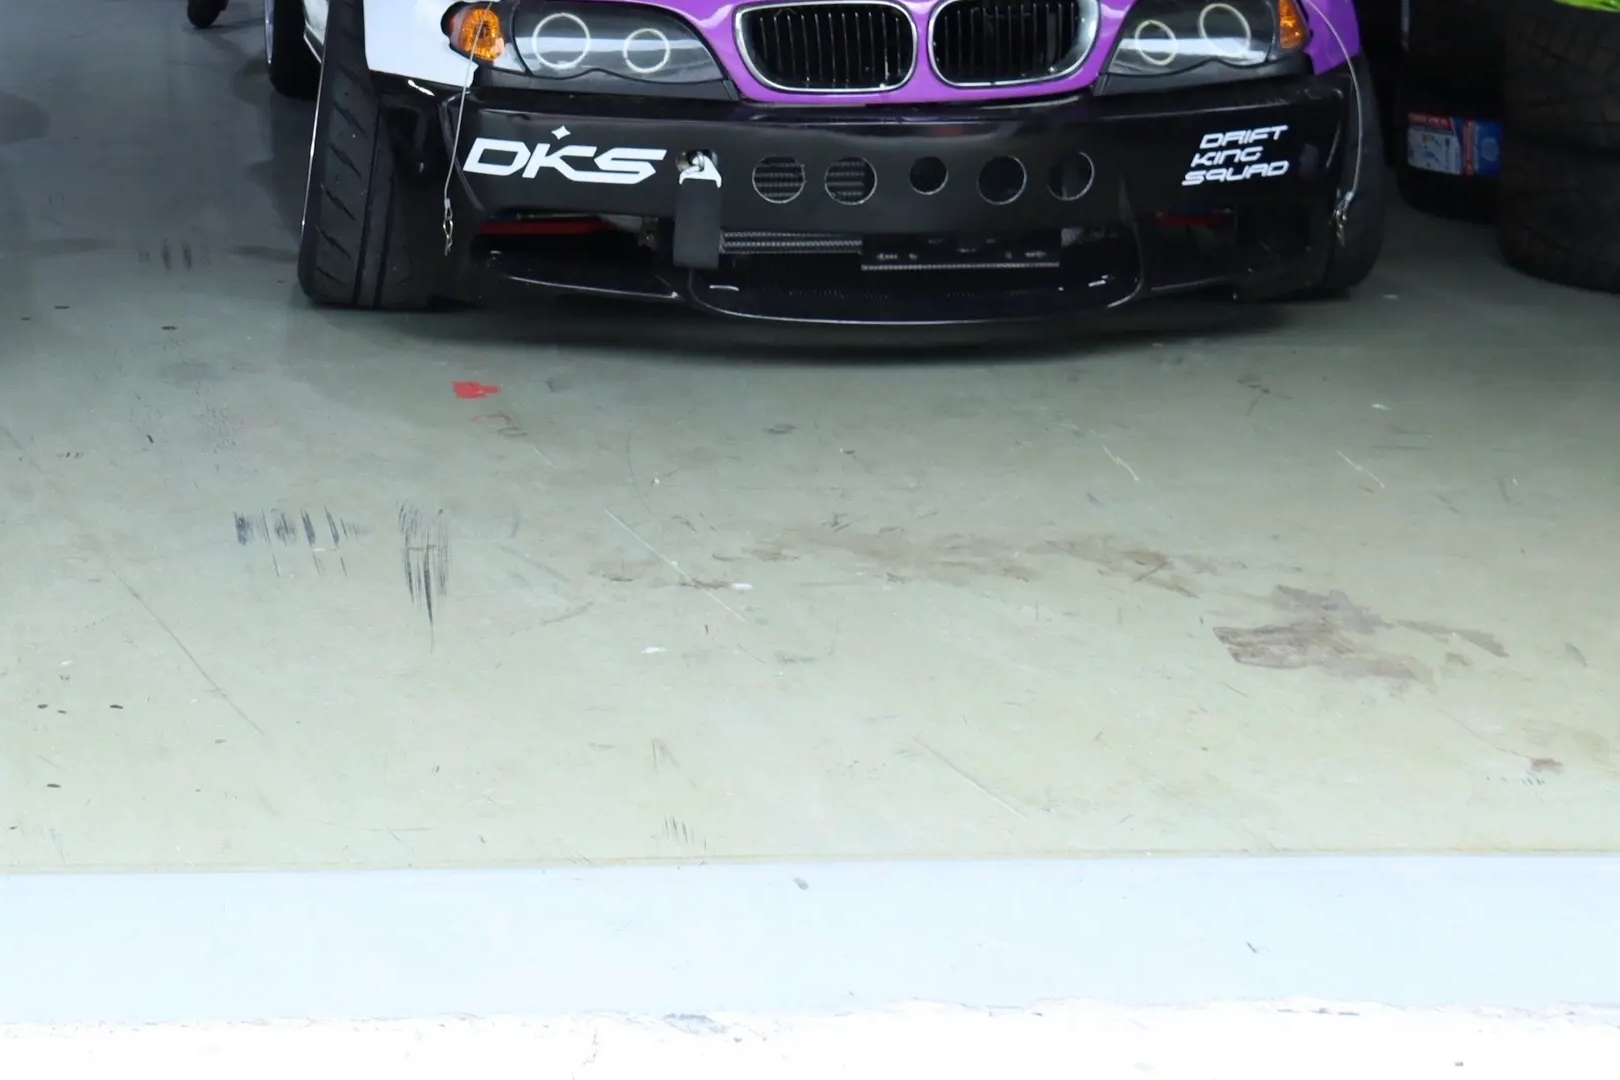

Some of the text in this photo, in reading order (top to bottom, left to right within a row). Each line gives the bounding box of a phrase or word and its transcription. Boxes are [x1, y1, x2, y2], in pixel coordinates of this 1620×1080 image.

[1199, 124, 1289, 149] DRIFT
[463, 137, 668, 185] DKS
[1181, 160, 1290, 186] SQUAD
